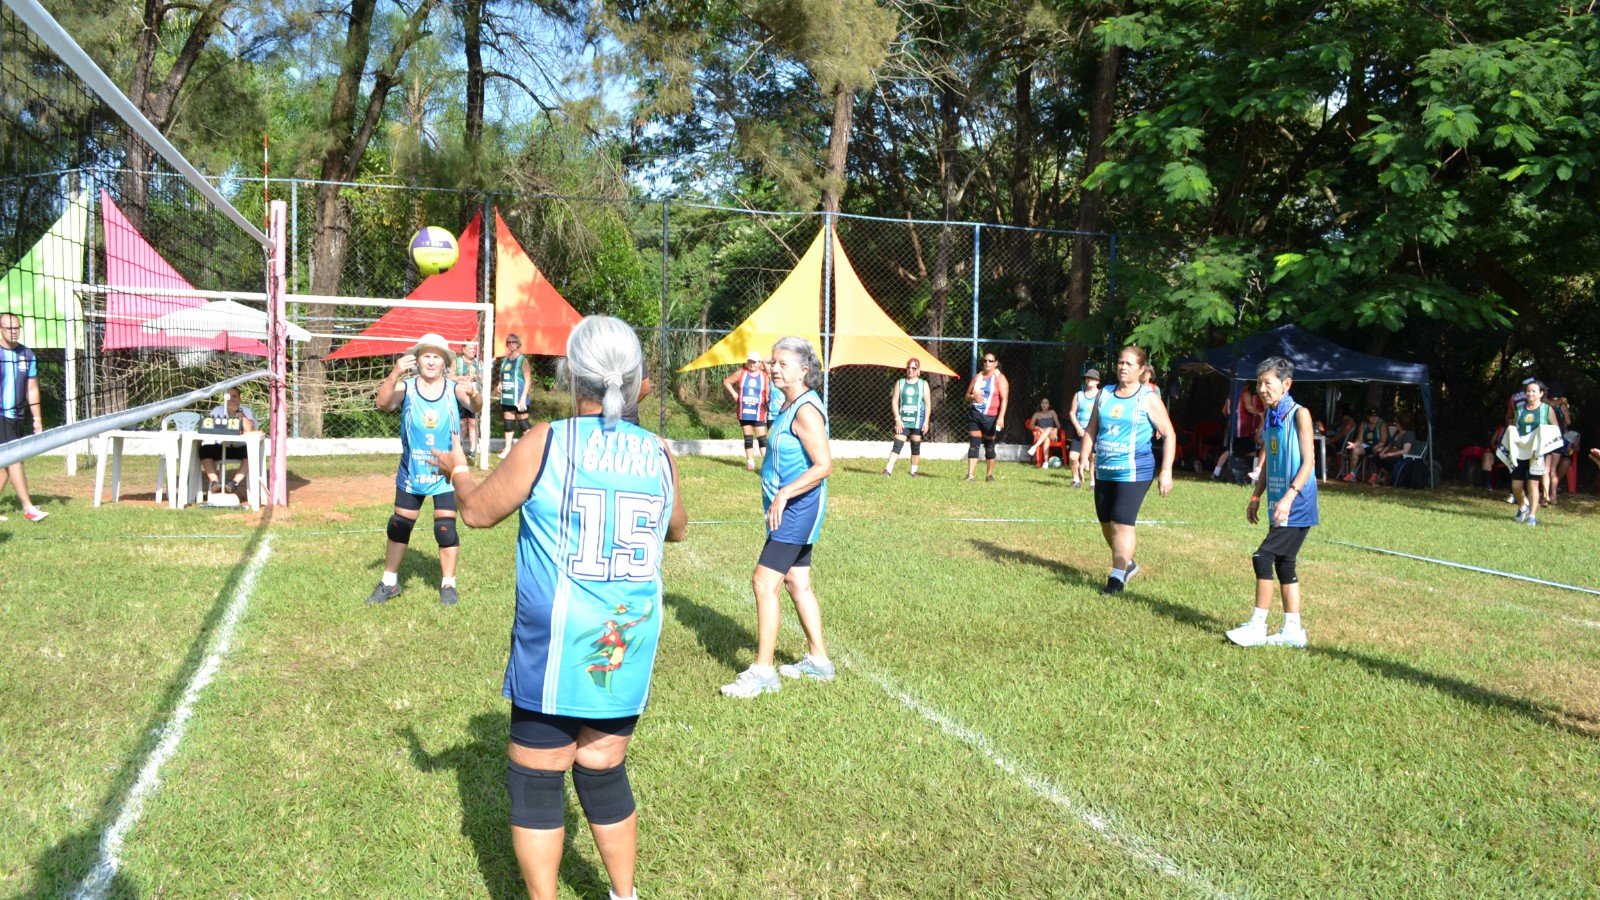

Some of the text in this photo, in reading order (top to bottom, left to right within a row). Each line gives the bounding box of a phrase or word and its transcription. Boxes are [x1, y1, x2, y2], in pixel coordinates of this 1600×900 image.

[203, 417, 214, 428] 6
[228, 418, 240, 430] 13
[1107, 423, 1120, 436] 14
[425, 433, 435, 446] 3
[587, 428, 655, 456] ATIBA
[582, 448, 660, 478] BAURU
[567, 486, 666, 583] 15
